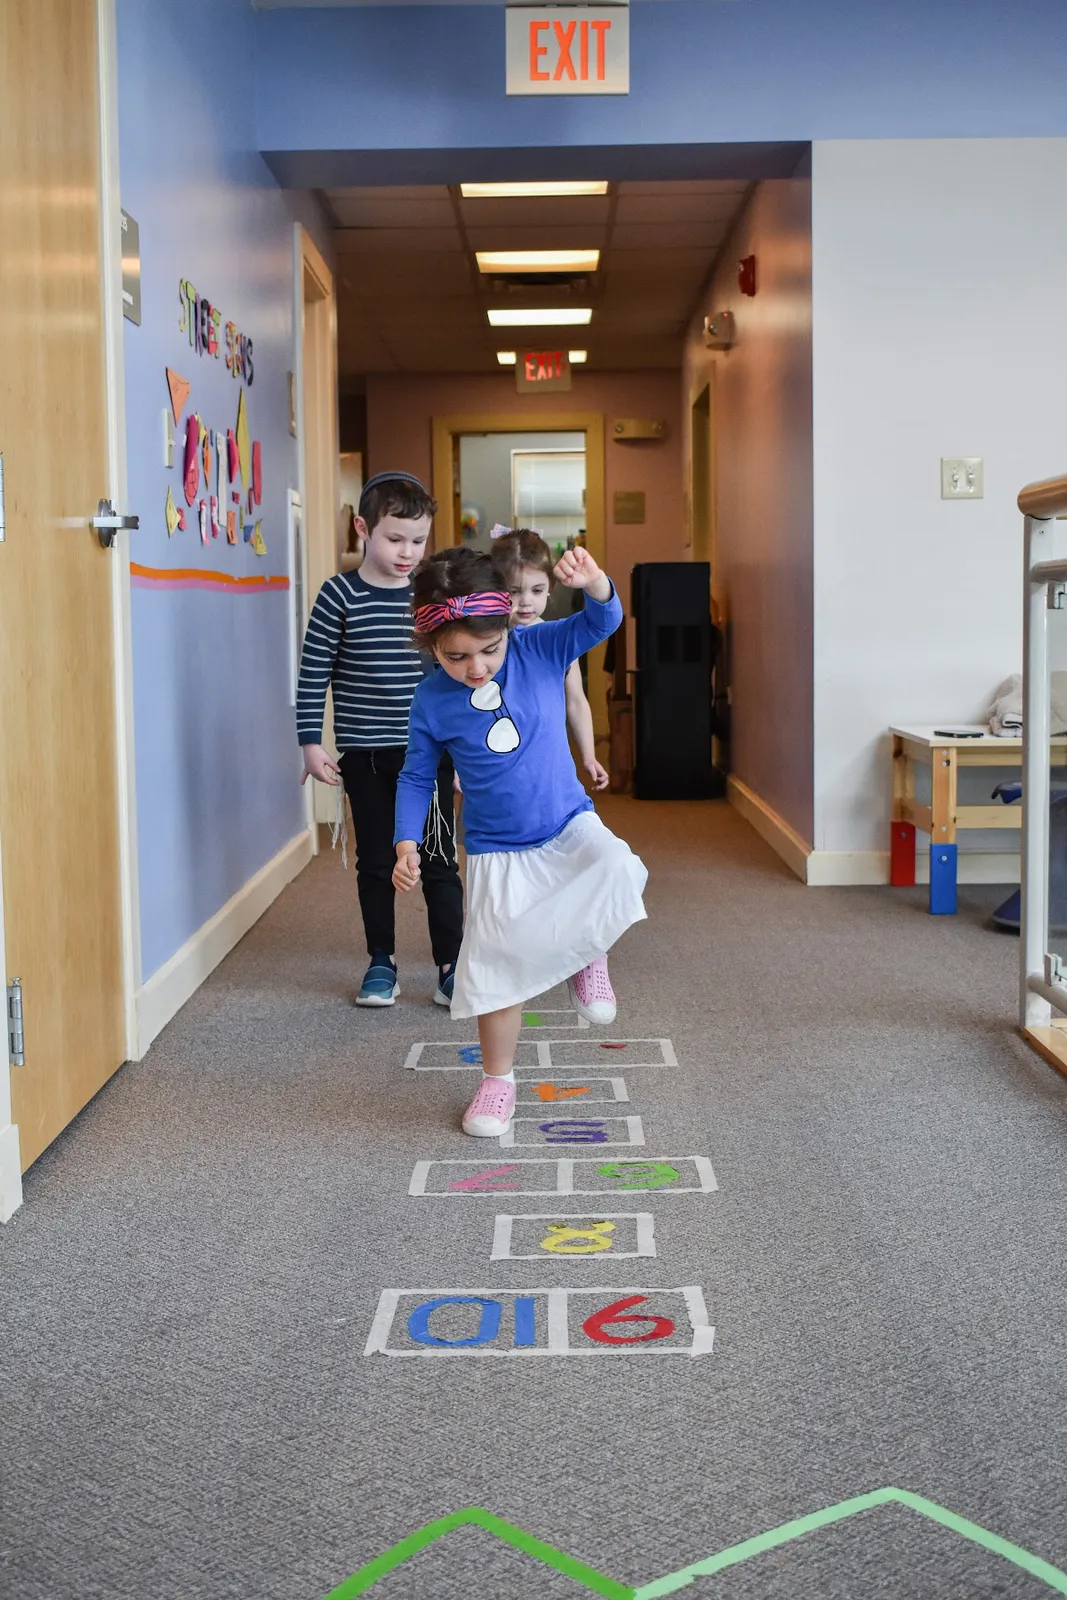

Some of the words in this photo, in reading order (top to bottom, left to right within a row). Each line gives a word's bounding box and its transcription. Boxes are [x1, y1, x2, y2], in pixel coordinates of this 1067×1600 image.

[529, 20, 611, 81] EXIT
[179, 278, 222, 359] STREET
[525, 352, 564, 381] EXIT
[539, 1220, 616, 1254] 8
